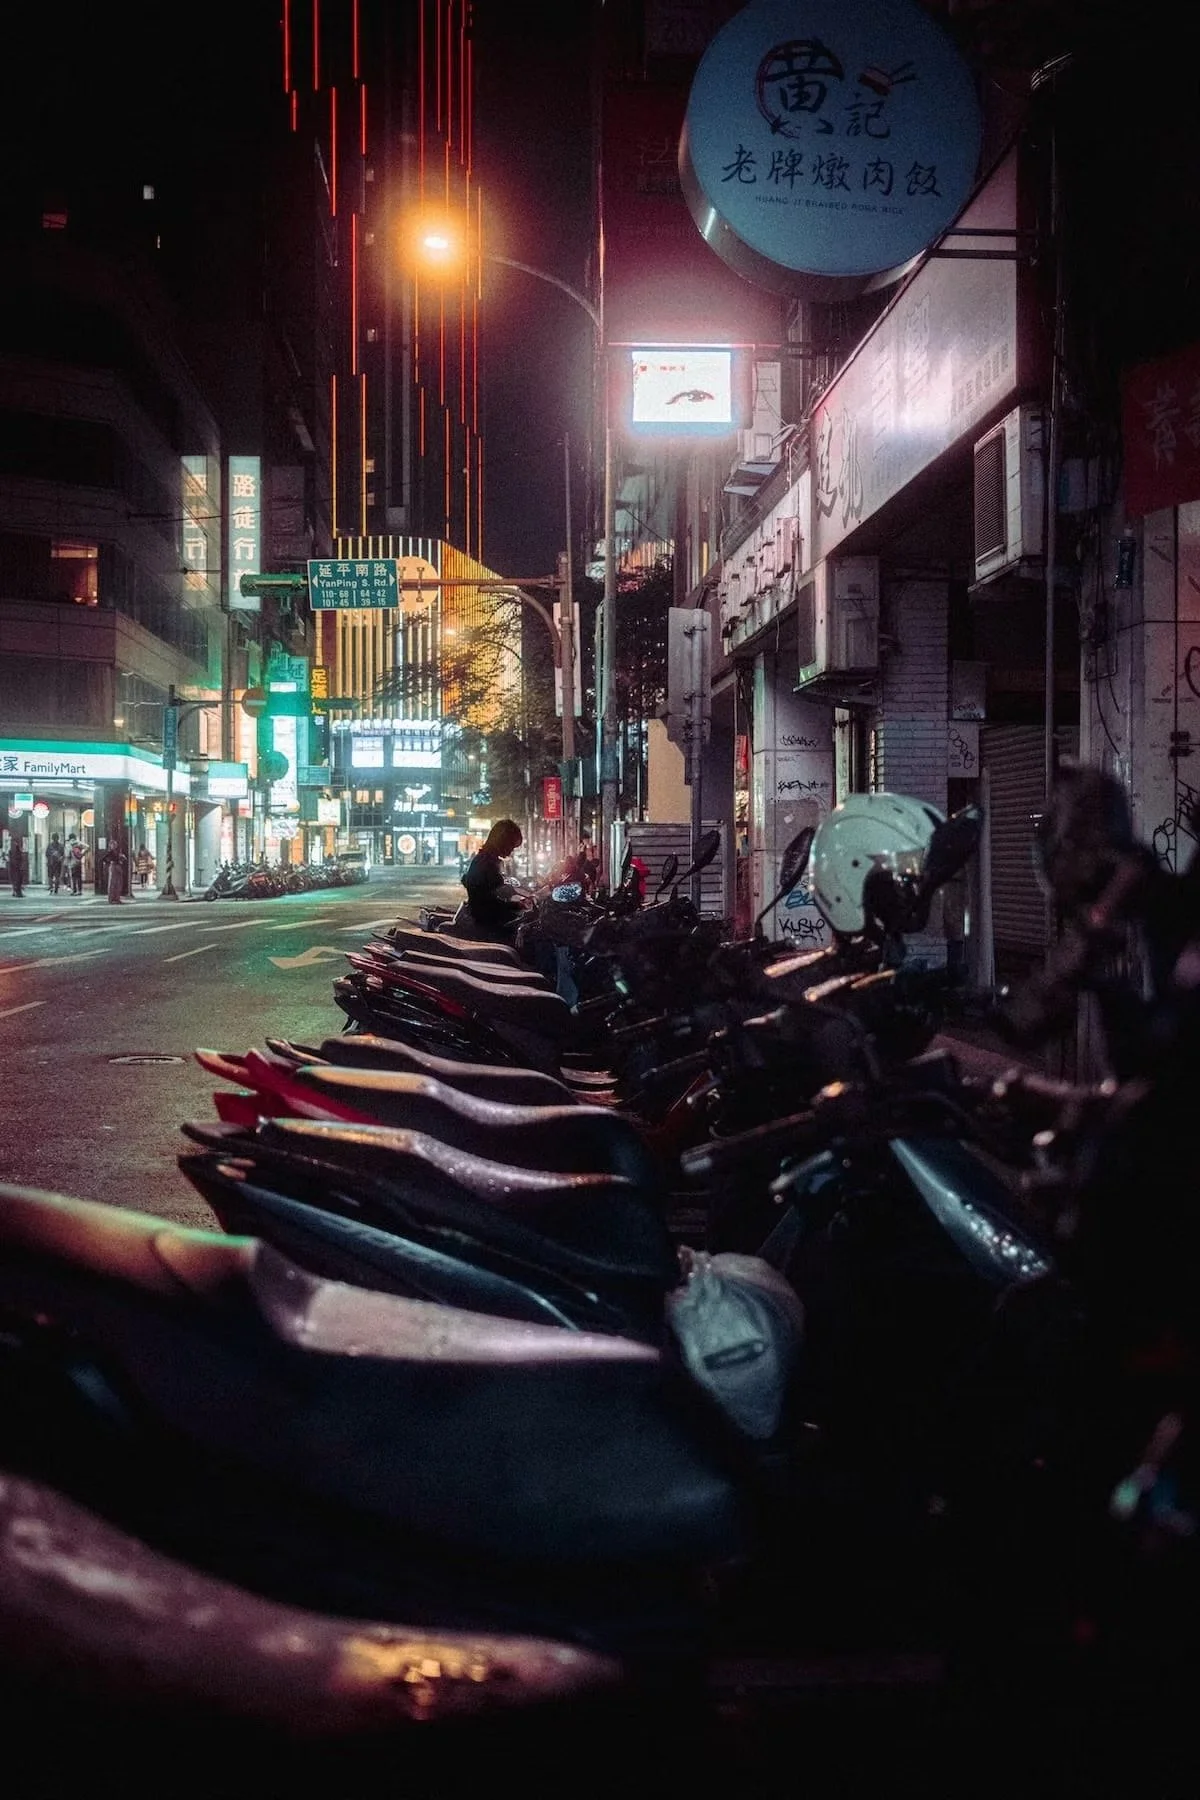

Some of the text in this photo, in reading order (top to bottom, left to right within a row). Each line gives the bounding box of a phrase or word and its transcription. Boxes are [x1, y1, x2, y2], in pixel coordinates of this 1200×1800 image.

[721, 143, 942, 198] 老牌燉肉飯
[755, 195, 788, 205] HUANG
[319, 563, 387, 577] 延平南路
[320, 578, 388, 589] YanPing S. Rd.
[0, 756, 19, 772] 家
[24, 761, 86, 775] FamilyMart
